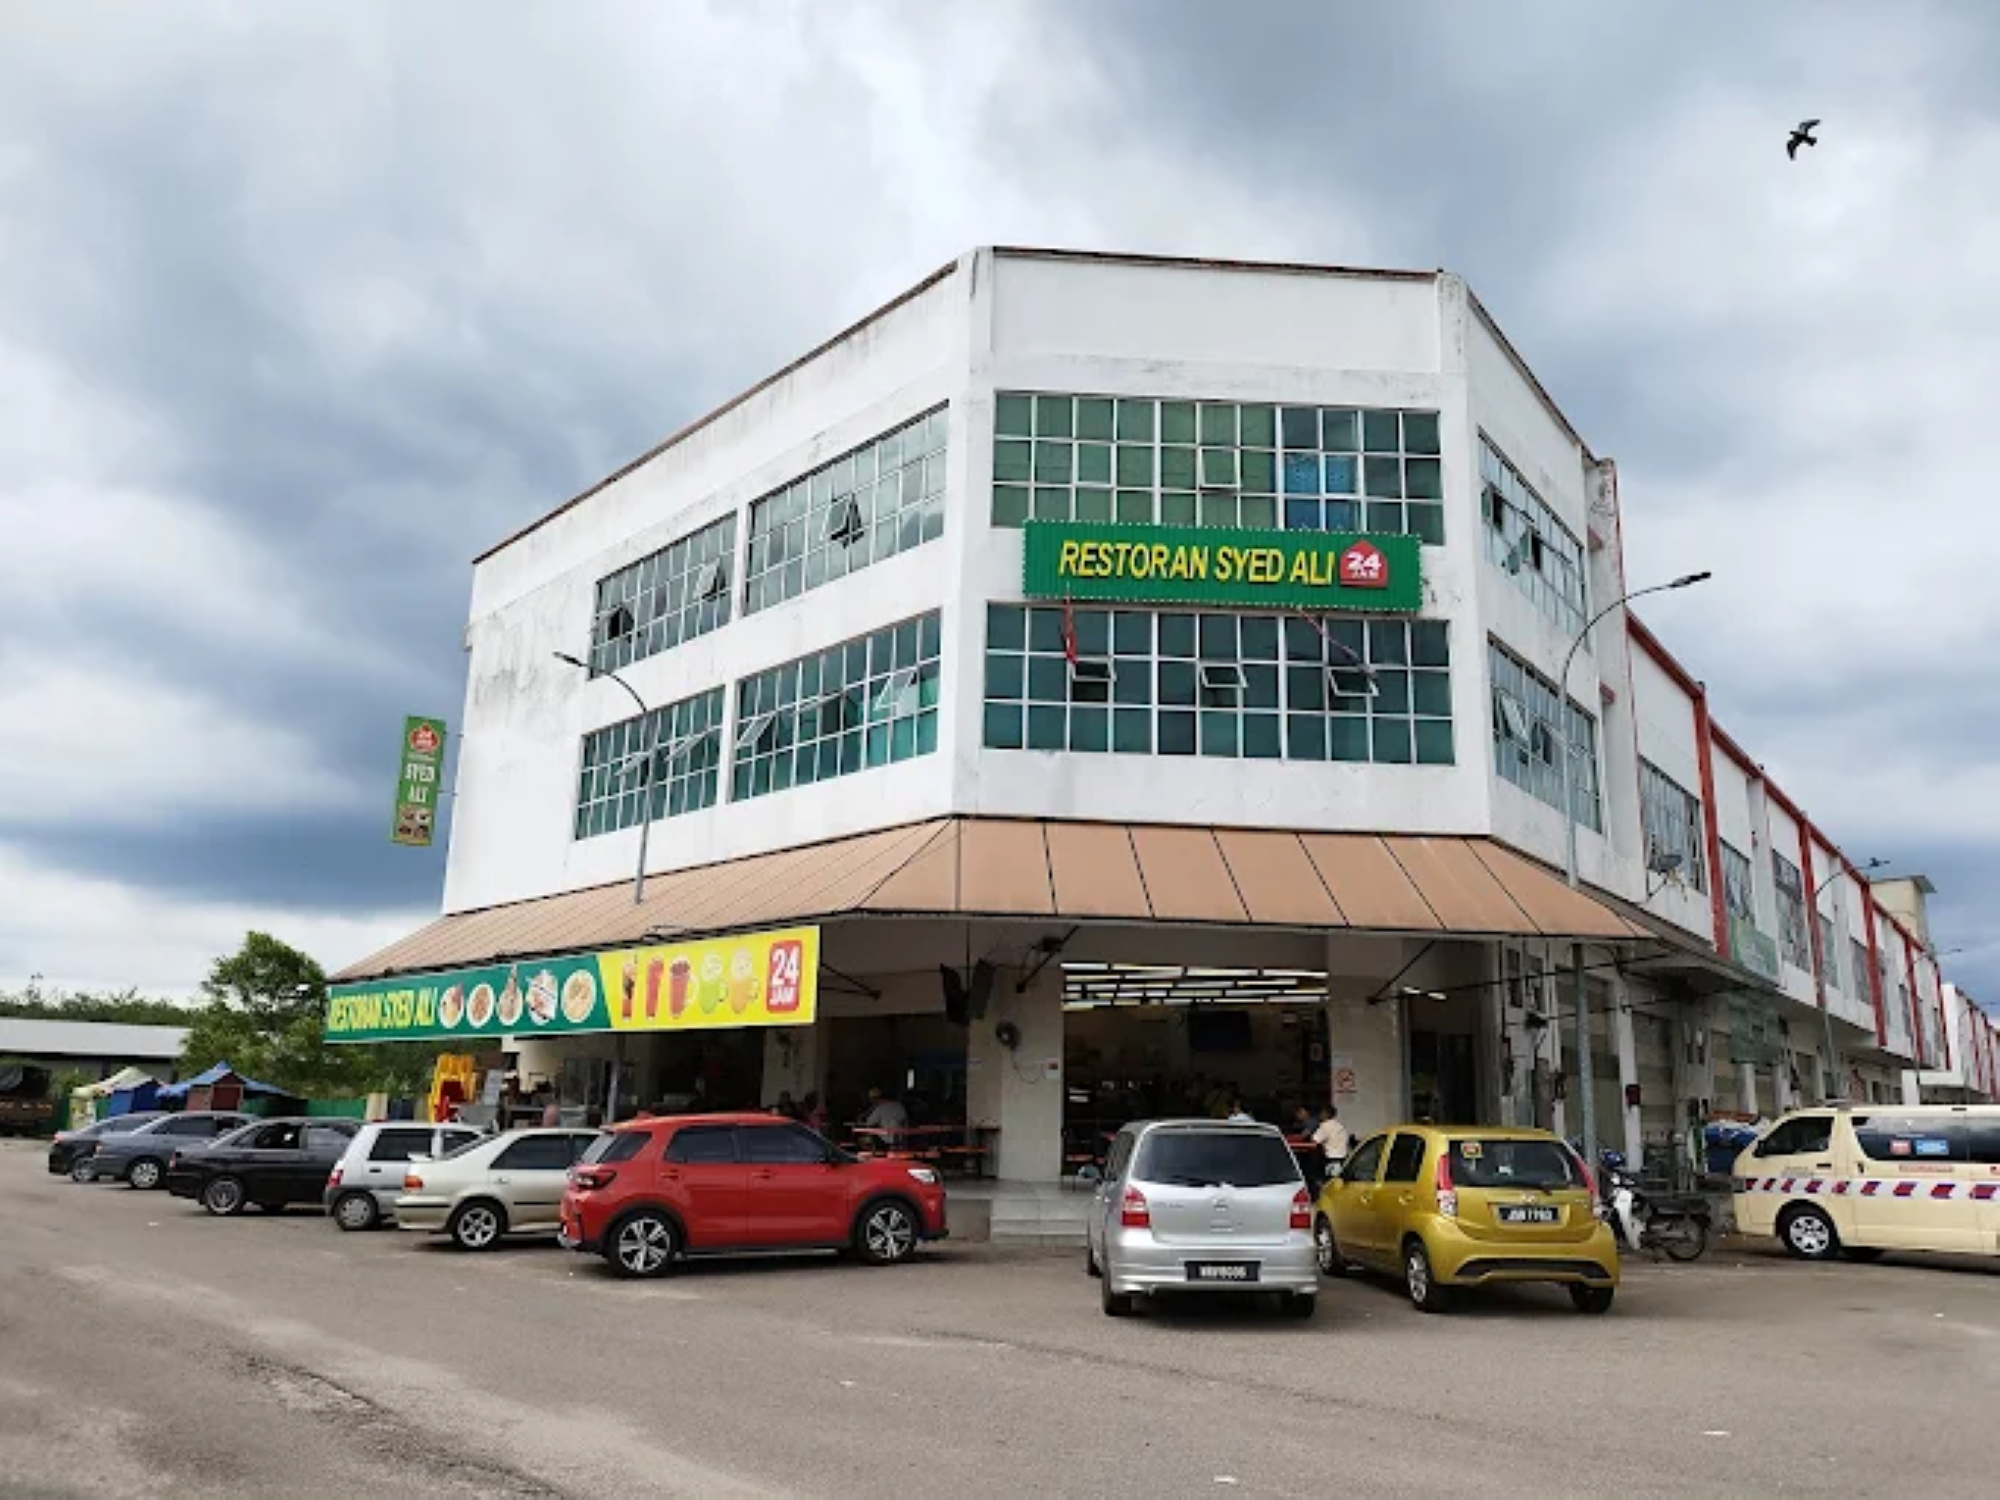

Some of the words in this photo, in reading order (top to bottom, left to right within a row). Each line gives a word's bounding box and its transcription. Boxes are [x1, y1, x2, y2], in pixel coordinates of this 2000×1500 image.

[1058, 540, 1209, 580] RESTORAN
[1213, 545, 1285, 582] SYED
[1289, 550, 1335, 585] ALI
[1346, 551, 1382, 571] 24
[772, 946, 799, 986] 24
